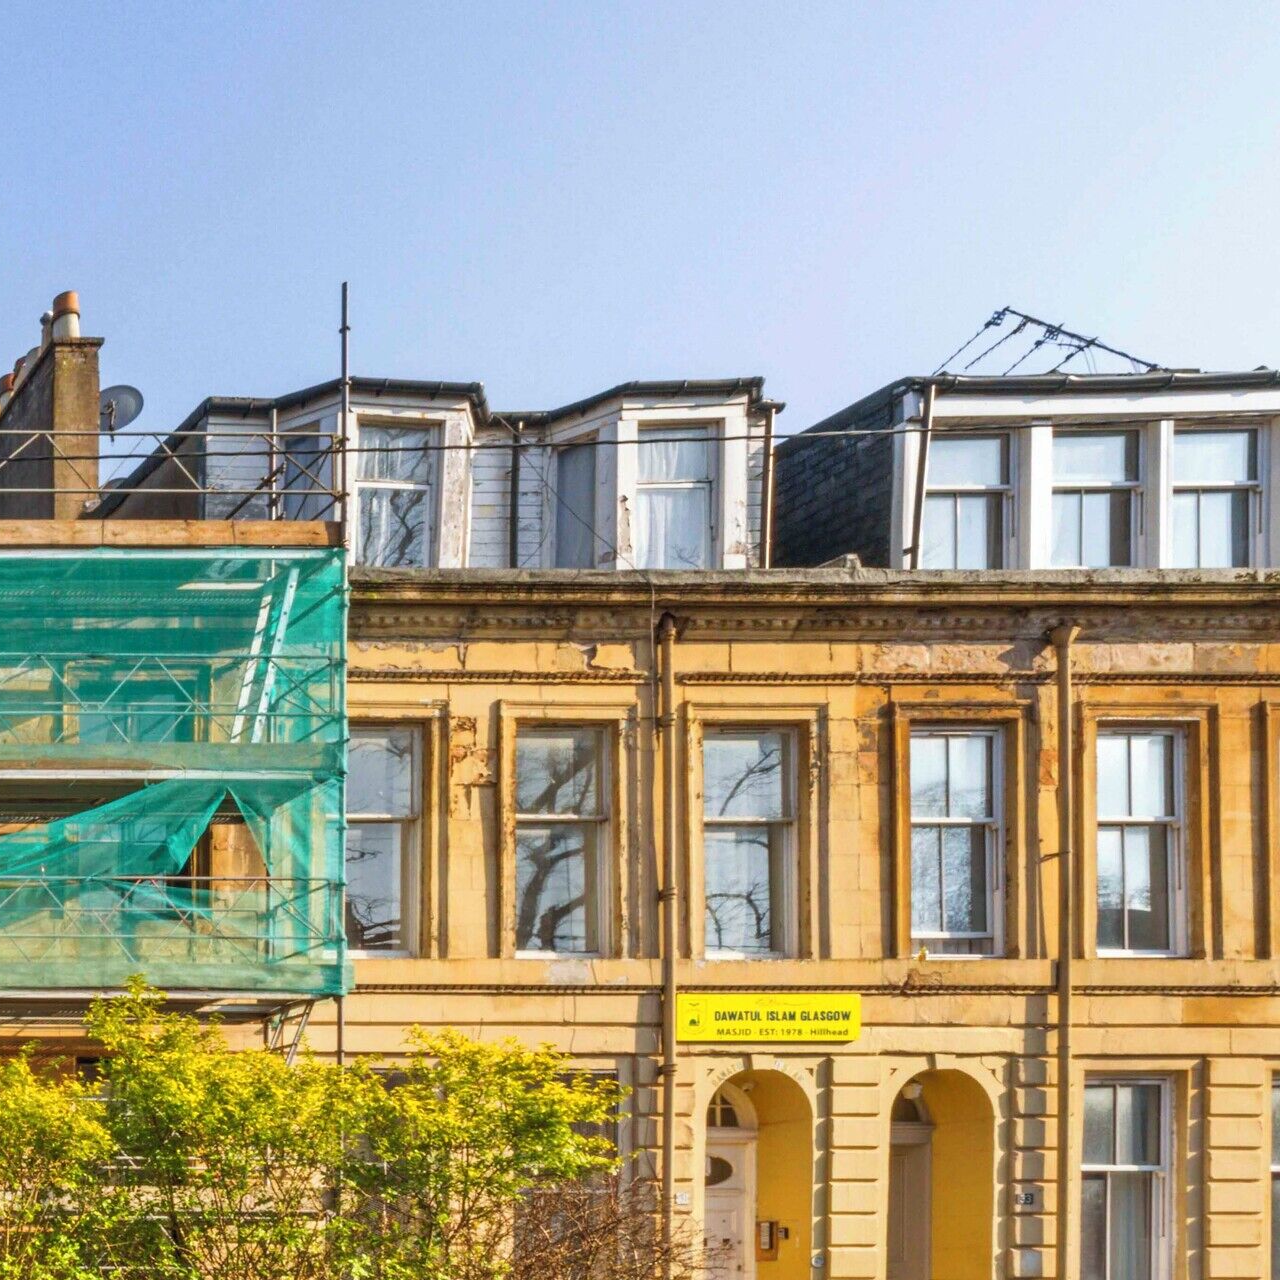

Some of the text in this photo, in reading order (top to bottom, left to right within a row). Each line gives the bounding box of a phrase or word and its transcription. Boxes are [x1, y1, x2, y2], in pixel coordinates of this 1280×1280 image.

[714, 1011, 851, 1021] DAWATUL ISLAM GLASGOW
[716, 1028, 752, 1036] MASJID
[781, 1028, 803, 1036] 1978
[810, 1028, 849, 1036] Hillhead
